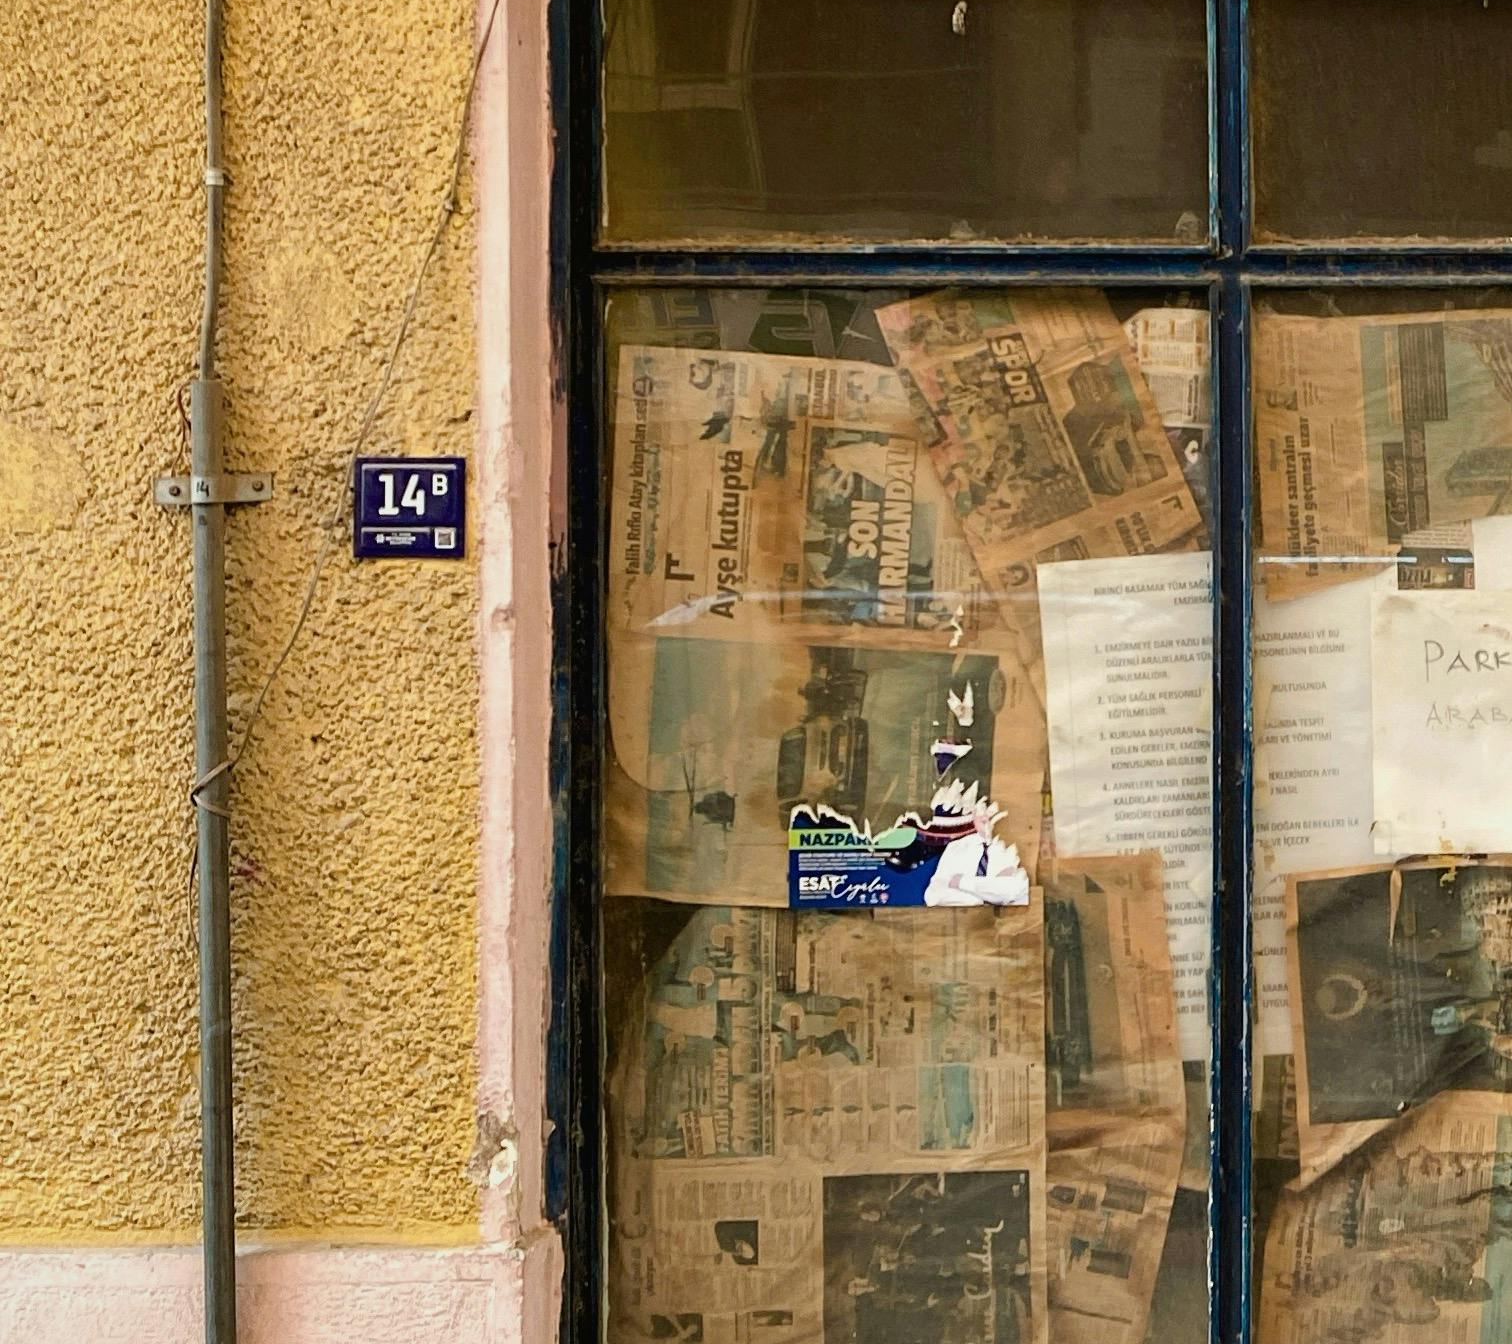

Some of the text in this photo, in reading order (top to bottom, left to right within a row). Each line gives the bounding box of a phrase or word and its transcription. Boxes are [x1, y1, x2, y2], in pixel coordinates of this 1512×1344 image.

[989, 337, 1037, 405] SPOR
[709, 450, 749, 620] Ayşe kutupta
[847, 500, 881, 560] SON
[799, 875, 842, 892] ESAT
